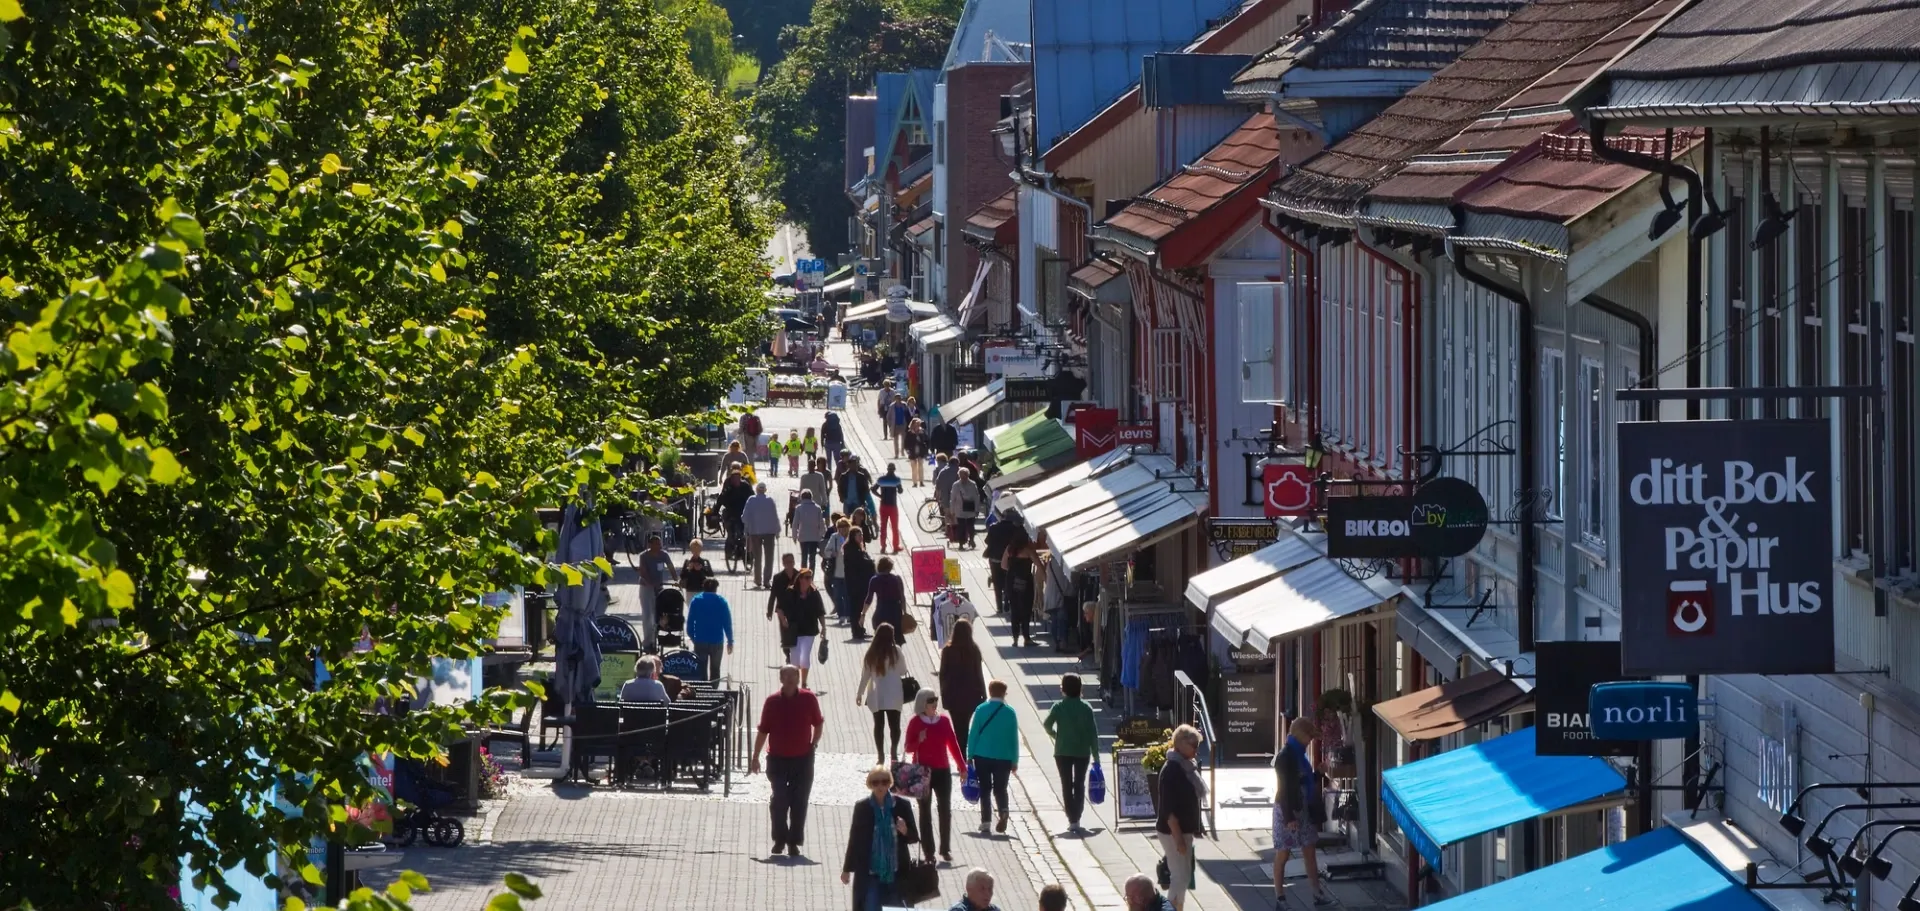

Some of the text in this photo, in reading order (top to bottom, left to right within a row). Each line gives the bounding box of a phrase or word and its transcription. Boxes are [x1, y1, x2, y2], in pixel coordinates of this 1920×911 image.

[814, 260, 822, 270] P
[1629, 456, 1816, 505] ditt Bok
[1345, 519, 1376, 537] BIK
[1698, 495, 1741, 539] &
[1664, 522, 1780, 584] Papir
[1730, 571, 1822, 616] Hus
[664, 656, 698, 670] OSCANA
[1603, 695, 1687, 724] norli
